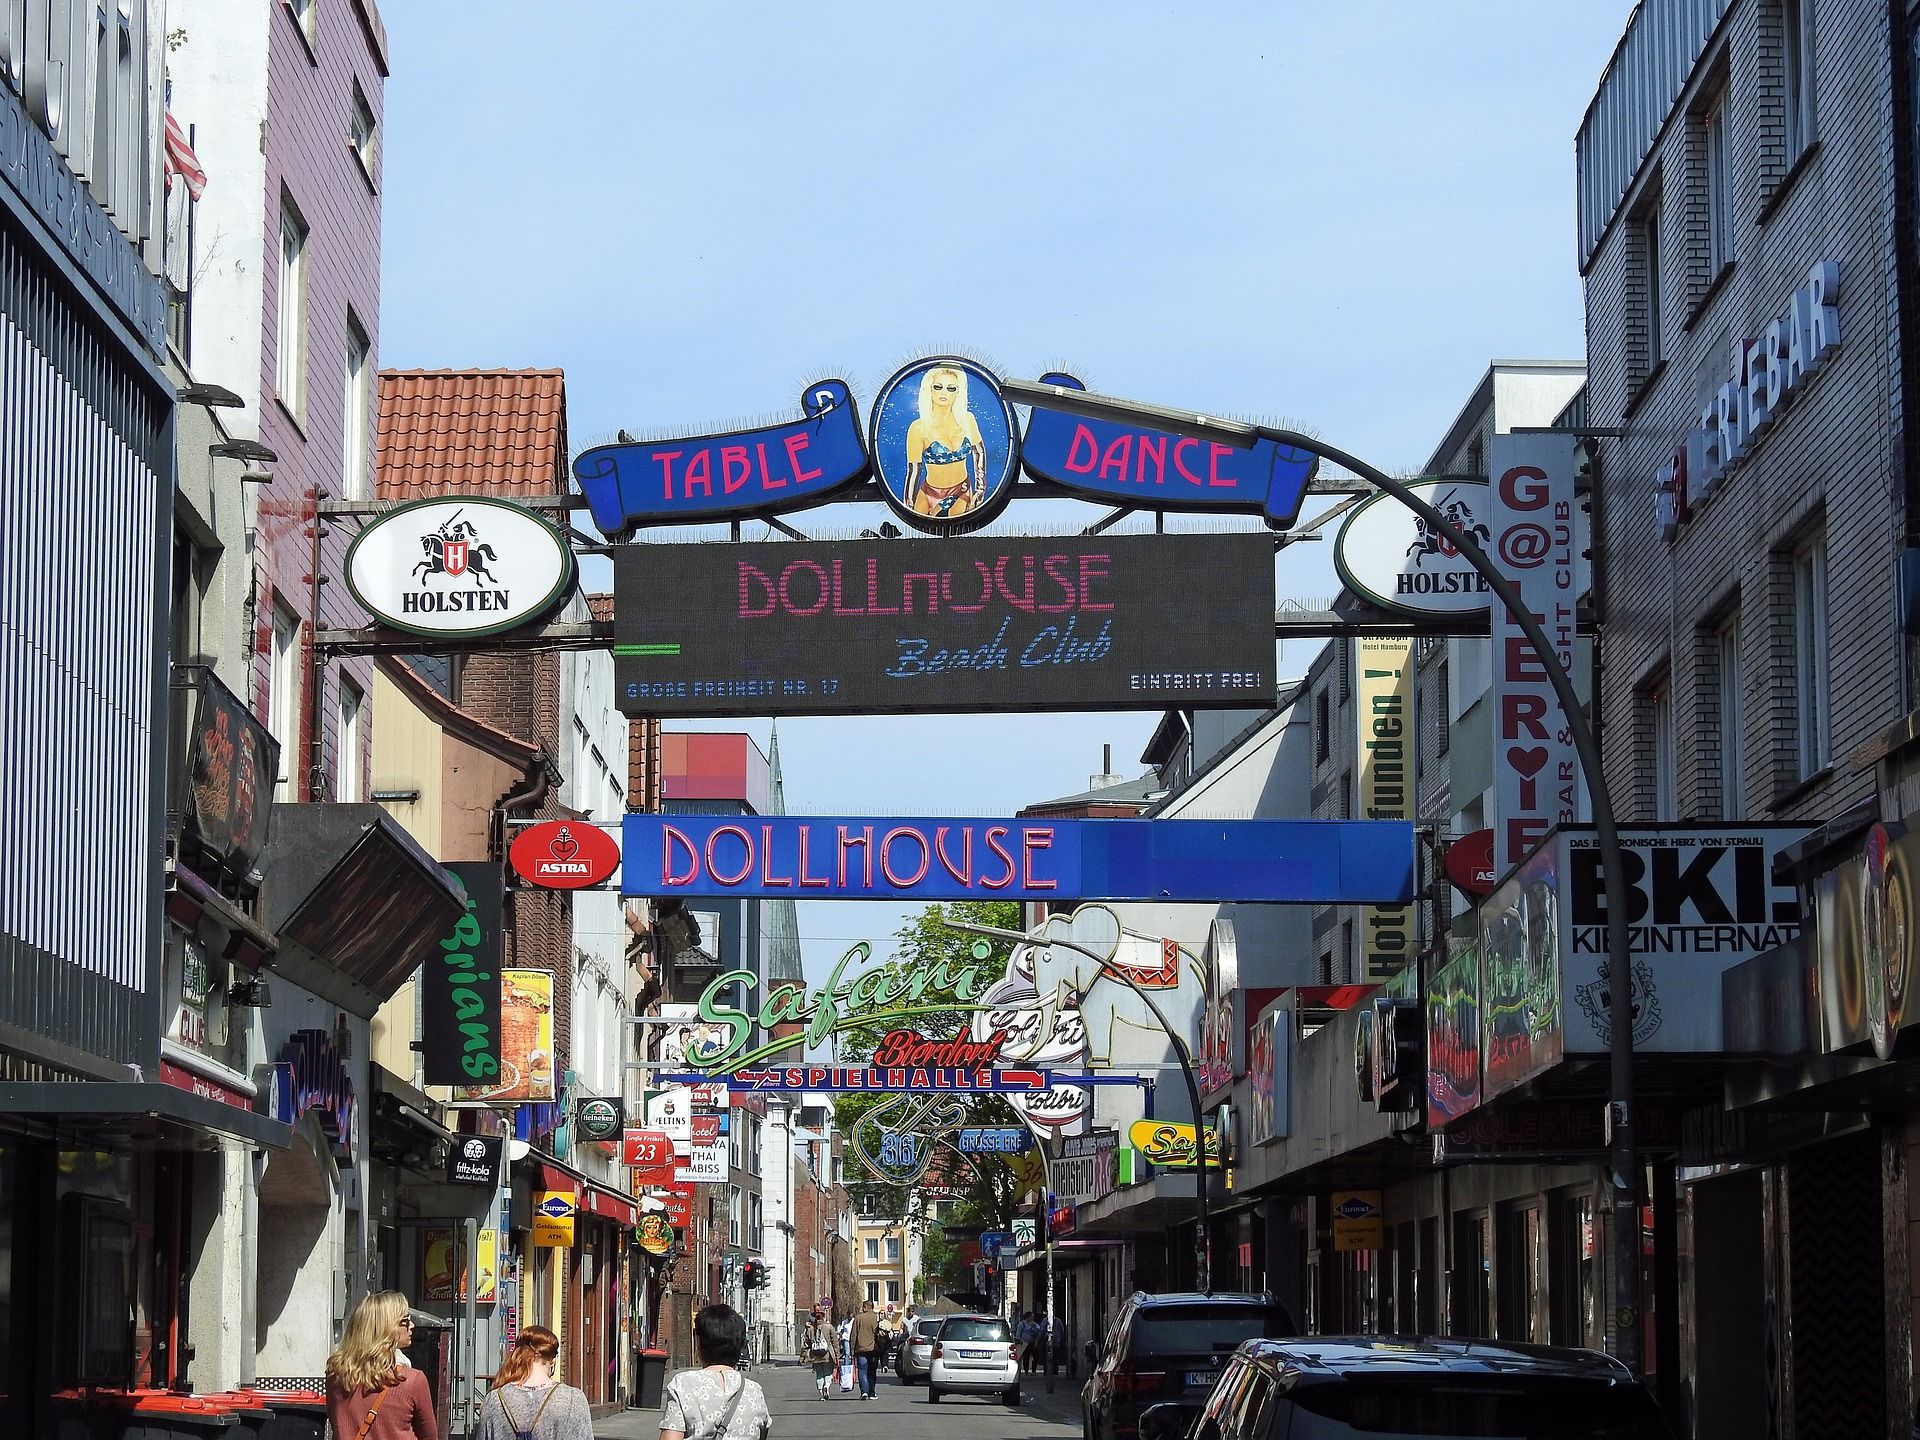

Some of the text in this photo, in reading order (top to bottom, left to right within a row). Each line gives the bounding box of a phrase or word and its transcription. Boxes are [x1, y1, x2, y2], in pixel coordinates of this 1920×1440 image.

[652, 432, 822, 499] TABLE
[1063, 423, 1238, 487] DANCE
[1555, 501, 1572, 589] CLUB
[739, 554, 1115, 618] DOLLHOUSE
[1397, 572, 1490, 594] HOLSTE
[402, 589, 510, 613] HOLSTEN
[885, 615, 1115, 679] Beach Club
[1362, 643, 1408, 651] Hotel Hamburg
[694, 680, 775, 697] FREIHEIT
[783, 680, 813, 696] NR.
[821, 679, 840, 695] 17
[1129, 672, 1262, 692] EINTRITT FREI
[1558, 727, 1573, 747] &
[1556, 760, 1574, 825] BAR
[1570, 838, 1589, 848] DAS
[1671, 838, 1696, 847] HERZ
[1699, 837, 1722, 846] VON
[662, 824, 1057, 890] DOLLHOUSE
[540, 863, 588, 874] ASTRA
[512, 973, 531, 981] Kaplan
[686, 939, 994, 1067] Safari
[874, 1028, 1007, 1079] Bierdorf
[786, 1068, 992, 1089] SPIELHALLE
[1025, 1085, 1086, 1110] Colibri
[583, 1113, 614, 1122] Heineken
[634, 1144, 656, 1161] 23
[691, 1152, 716, 1161] THAI
[881, 1133, 915, 1166] 36
[457, 1161, 490, 1175] fritz-kola
[1020, 1162, 1043, 1186] 36
[542, 1204, 570, 1212] Euronet
